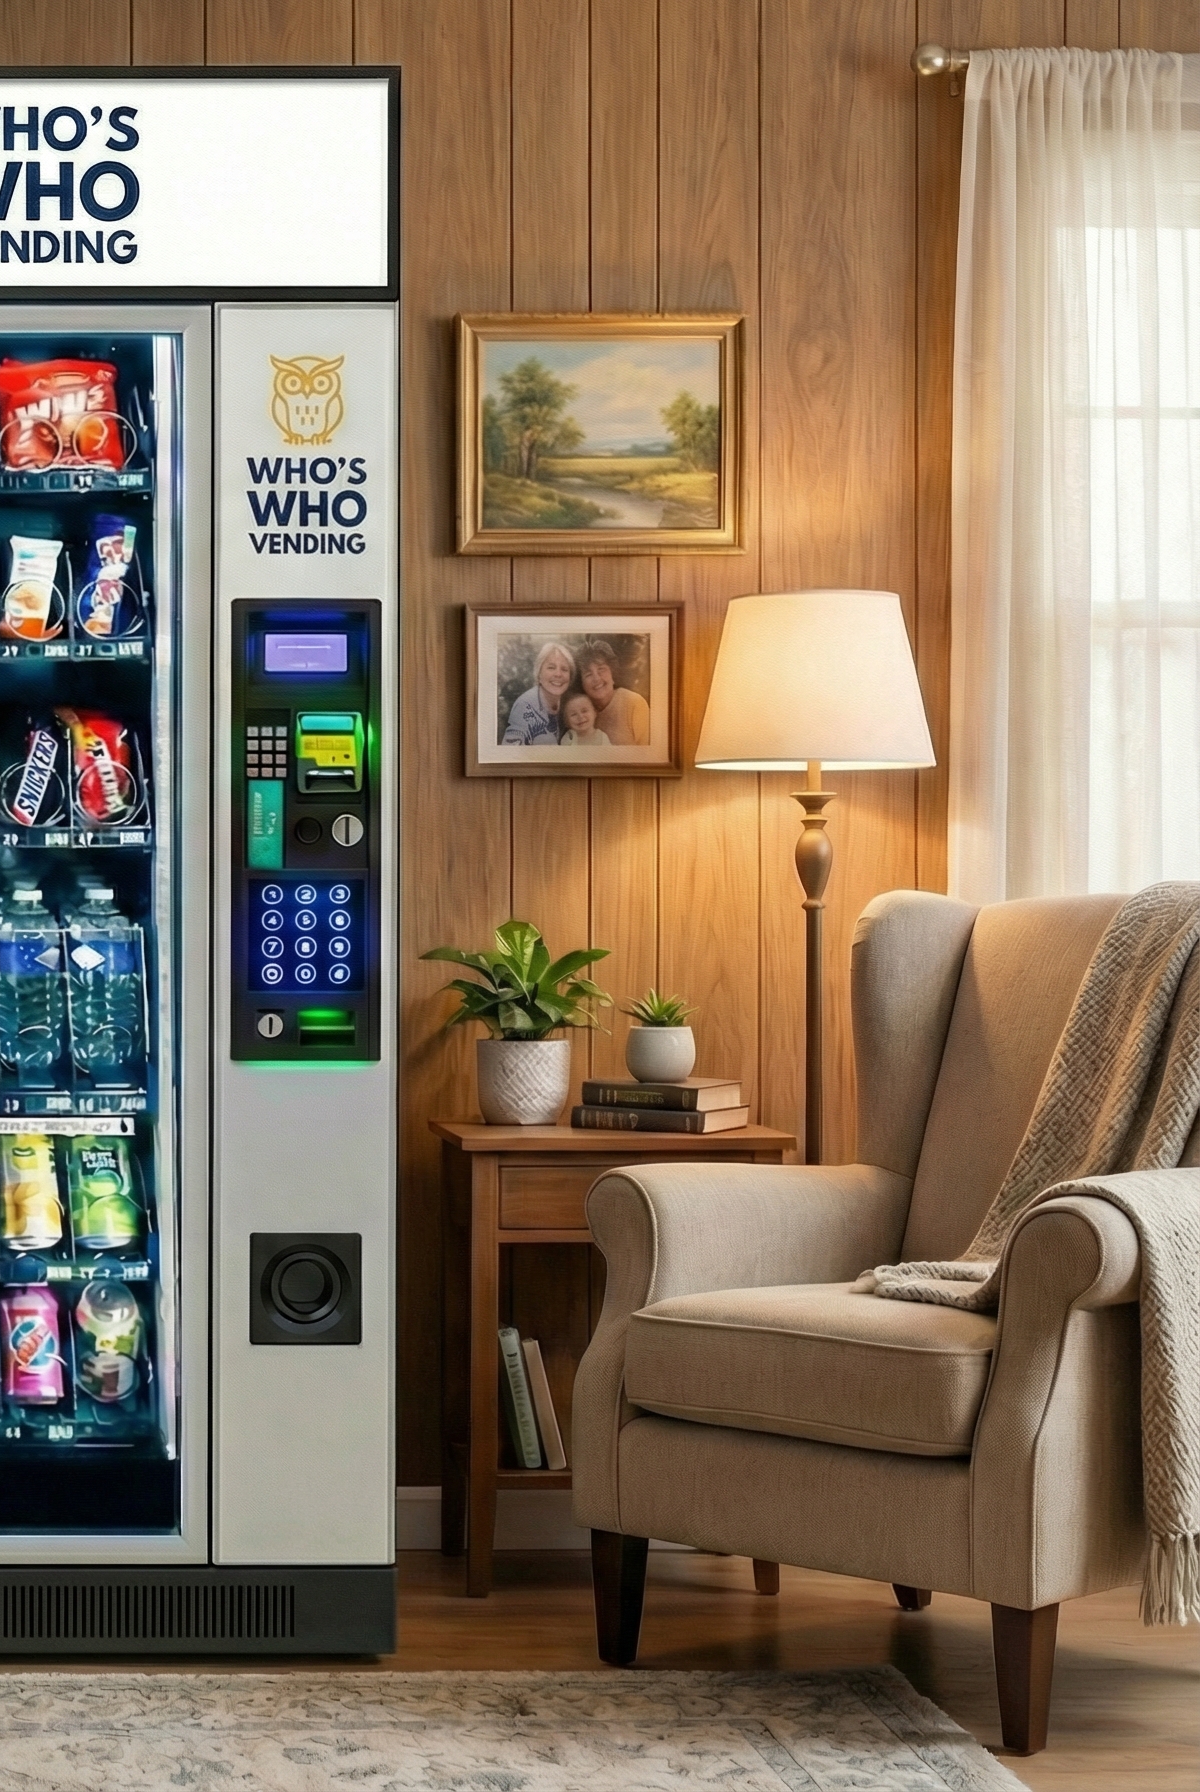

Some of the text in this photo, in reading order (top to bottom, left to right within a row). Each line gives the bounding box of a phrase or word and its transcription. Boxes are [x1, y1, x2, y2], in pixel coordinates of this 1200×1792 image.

[246, 456, 367, 485] WHO'S
[246, 489, 368, 528] WHO
[248, 532, 366, 555] VENDING
[17, 731, 57, 817] SNICKERS
[300, 889, 312, 900] 2
[335, 888, 346, 900] 3
[267, 941, 278, 953] 7
[300, 968, 311, 980] 0
